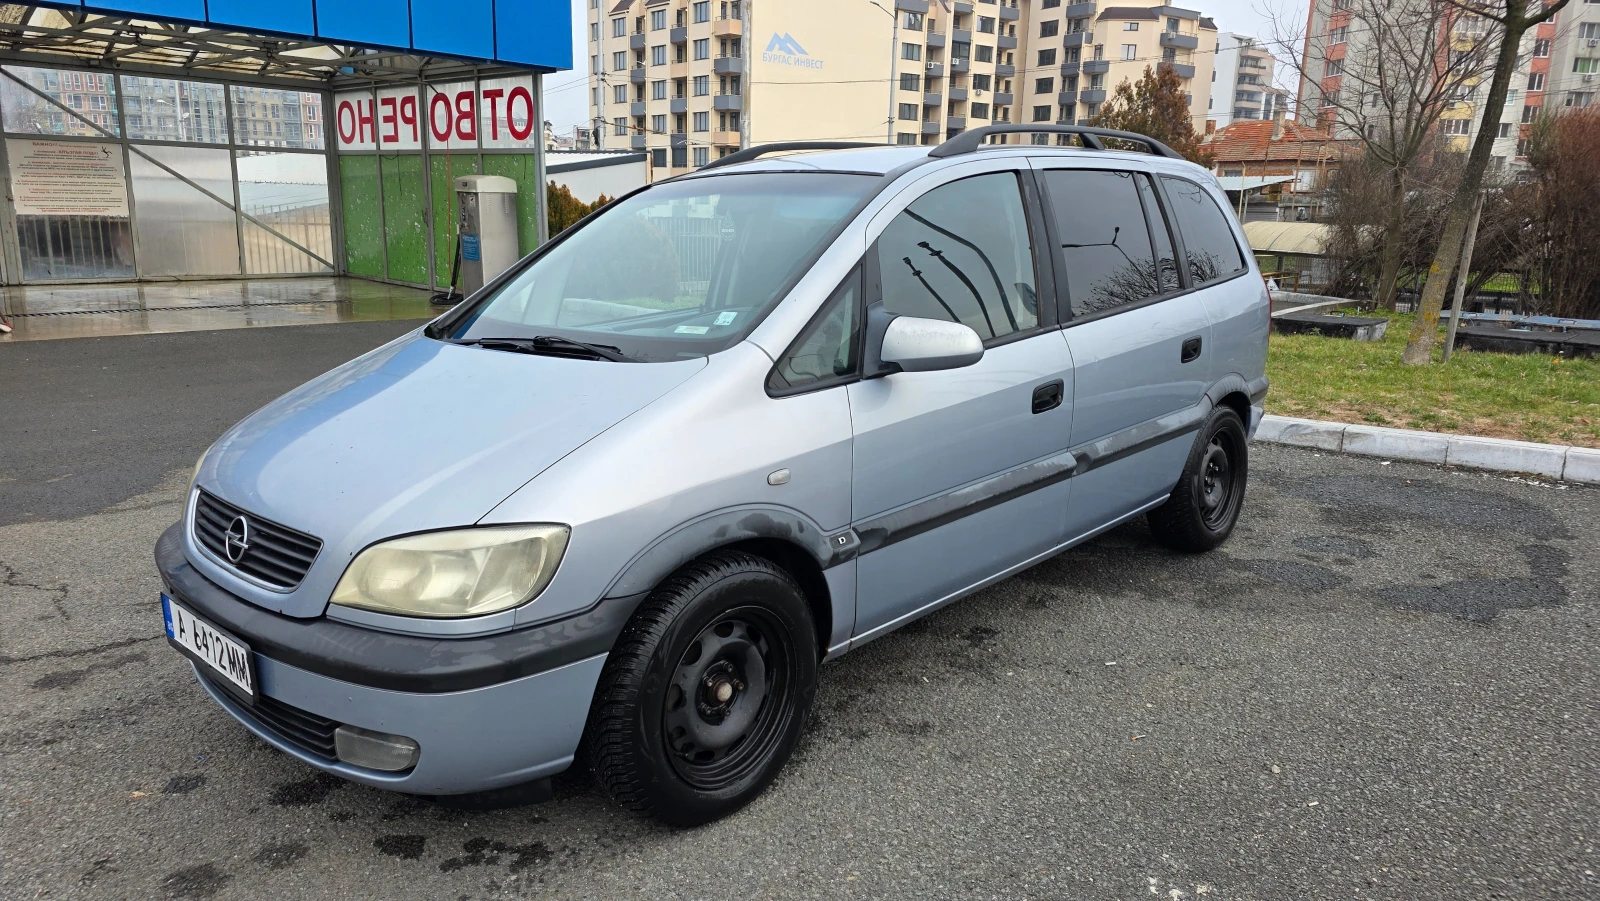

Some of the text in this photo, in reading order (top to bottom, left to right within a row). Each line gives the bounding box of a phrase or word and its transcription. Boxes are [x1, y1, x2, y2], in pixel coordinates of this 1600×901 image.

[762, 52, 823, 69] БУРГАС ИНВЕСТ
[178, 609, 188, 642] A
